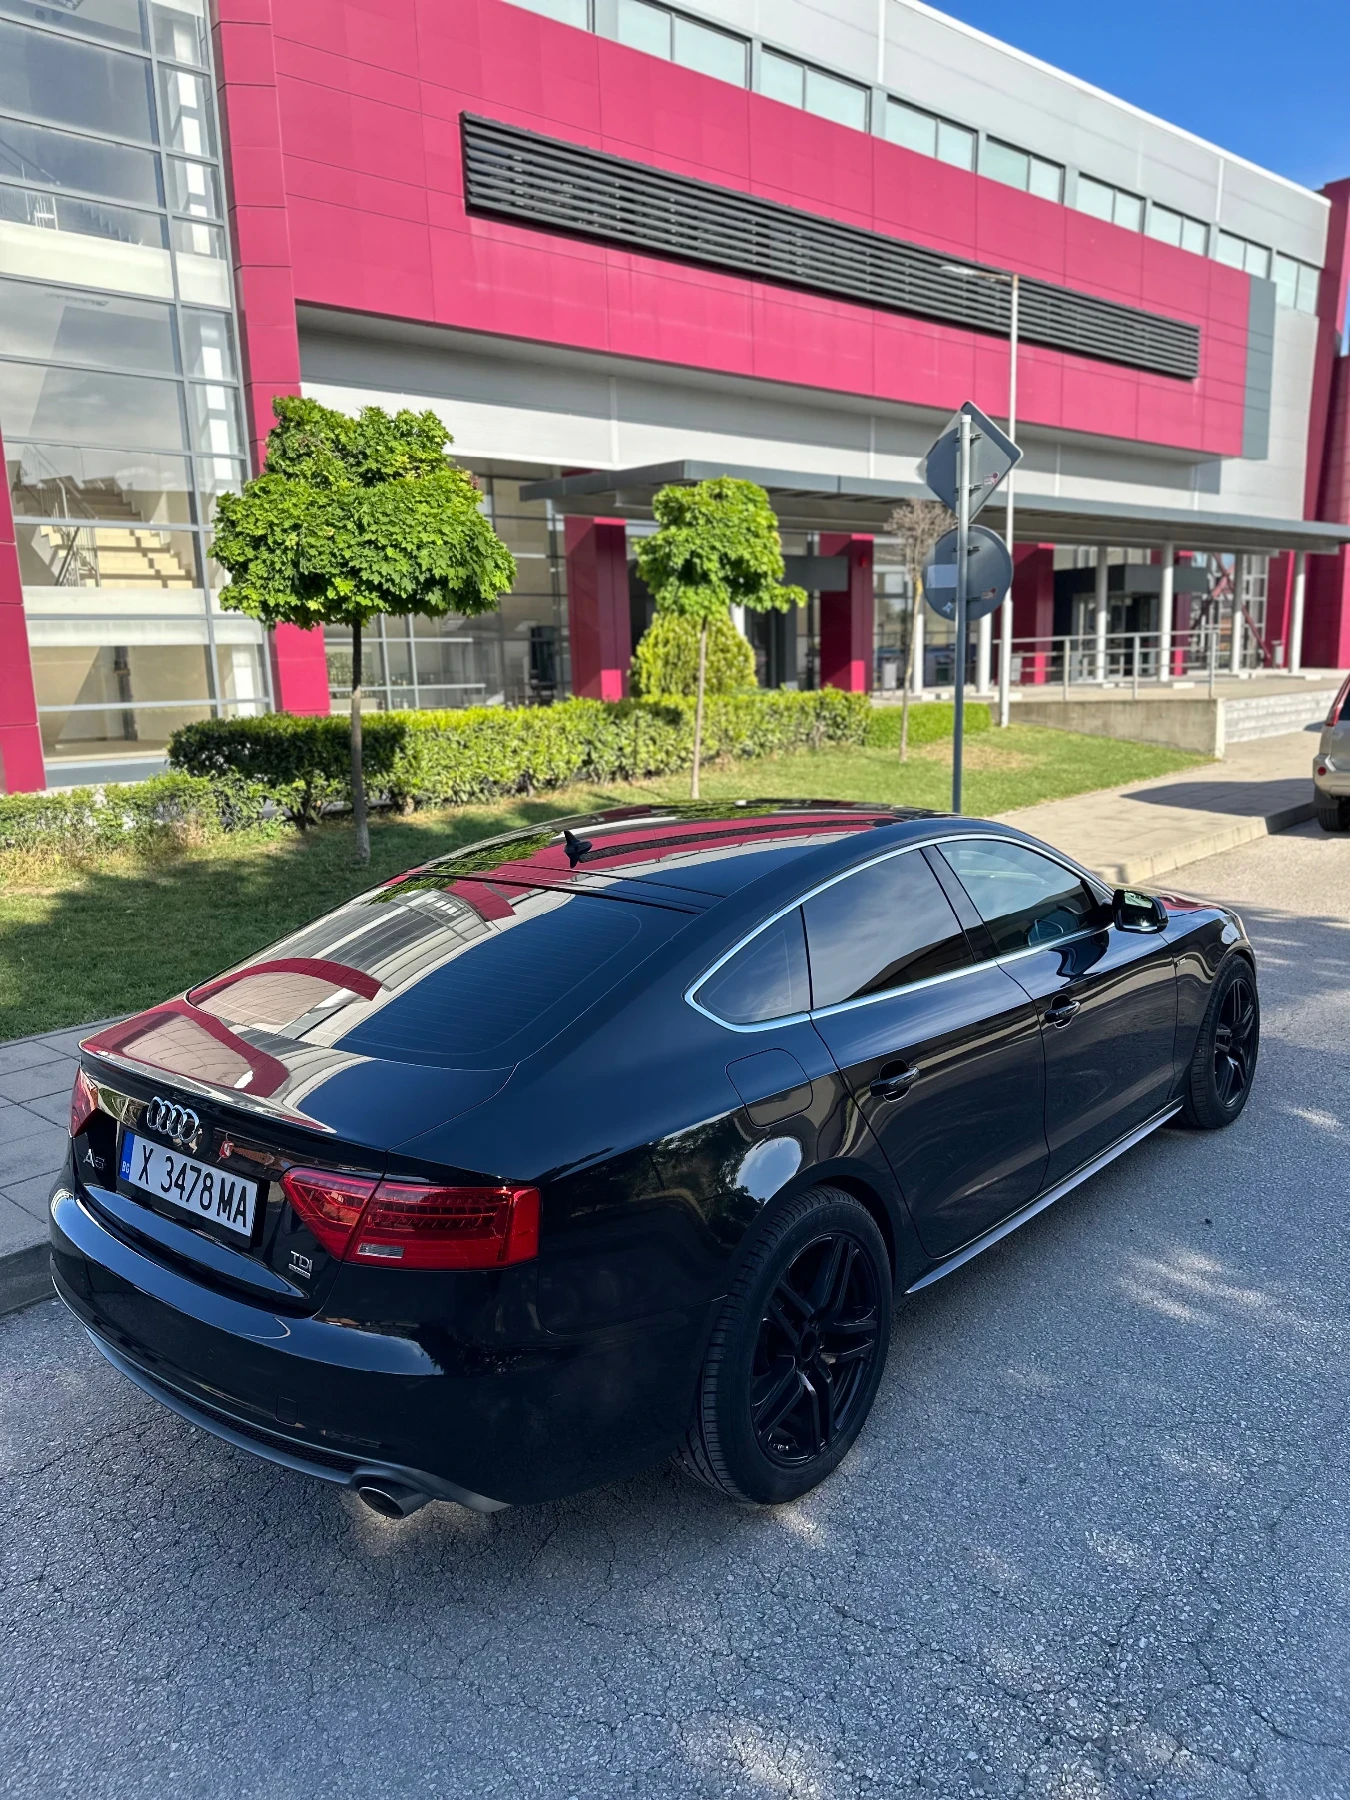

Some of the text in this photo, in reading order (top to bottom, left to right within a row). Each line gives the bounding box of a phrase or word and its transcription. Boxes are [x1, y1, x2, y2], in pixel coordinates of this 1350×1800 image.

[121, 1160, 130, 1174] BG
[138, 1144, 247, 1228] X 3478 MA
[290, 1250, 312, 1272] TDI
